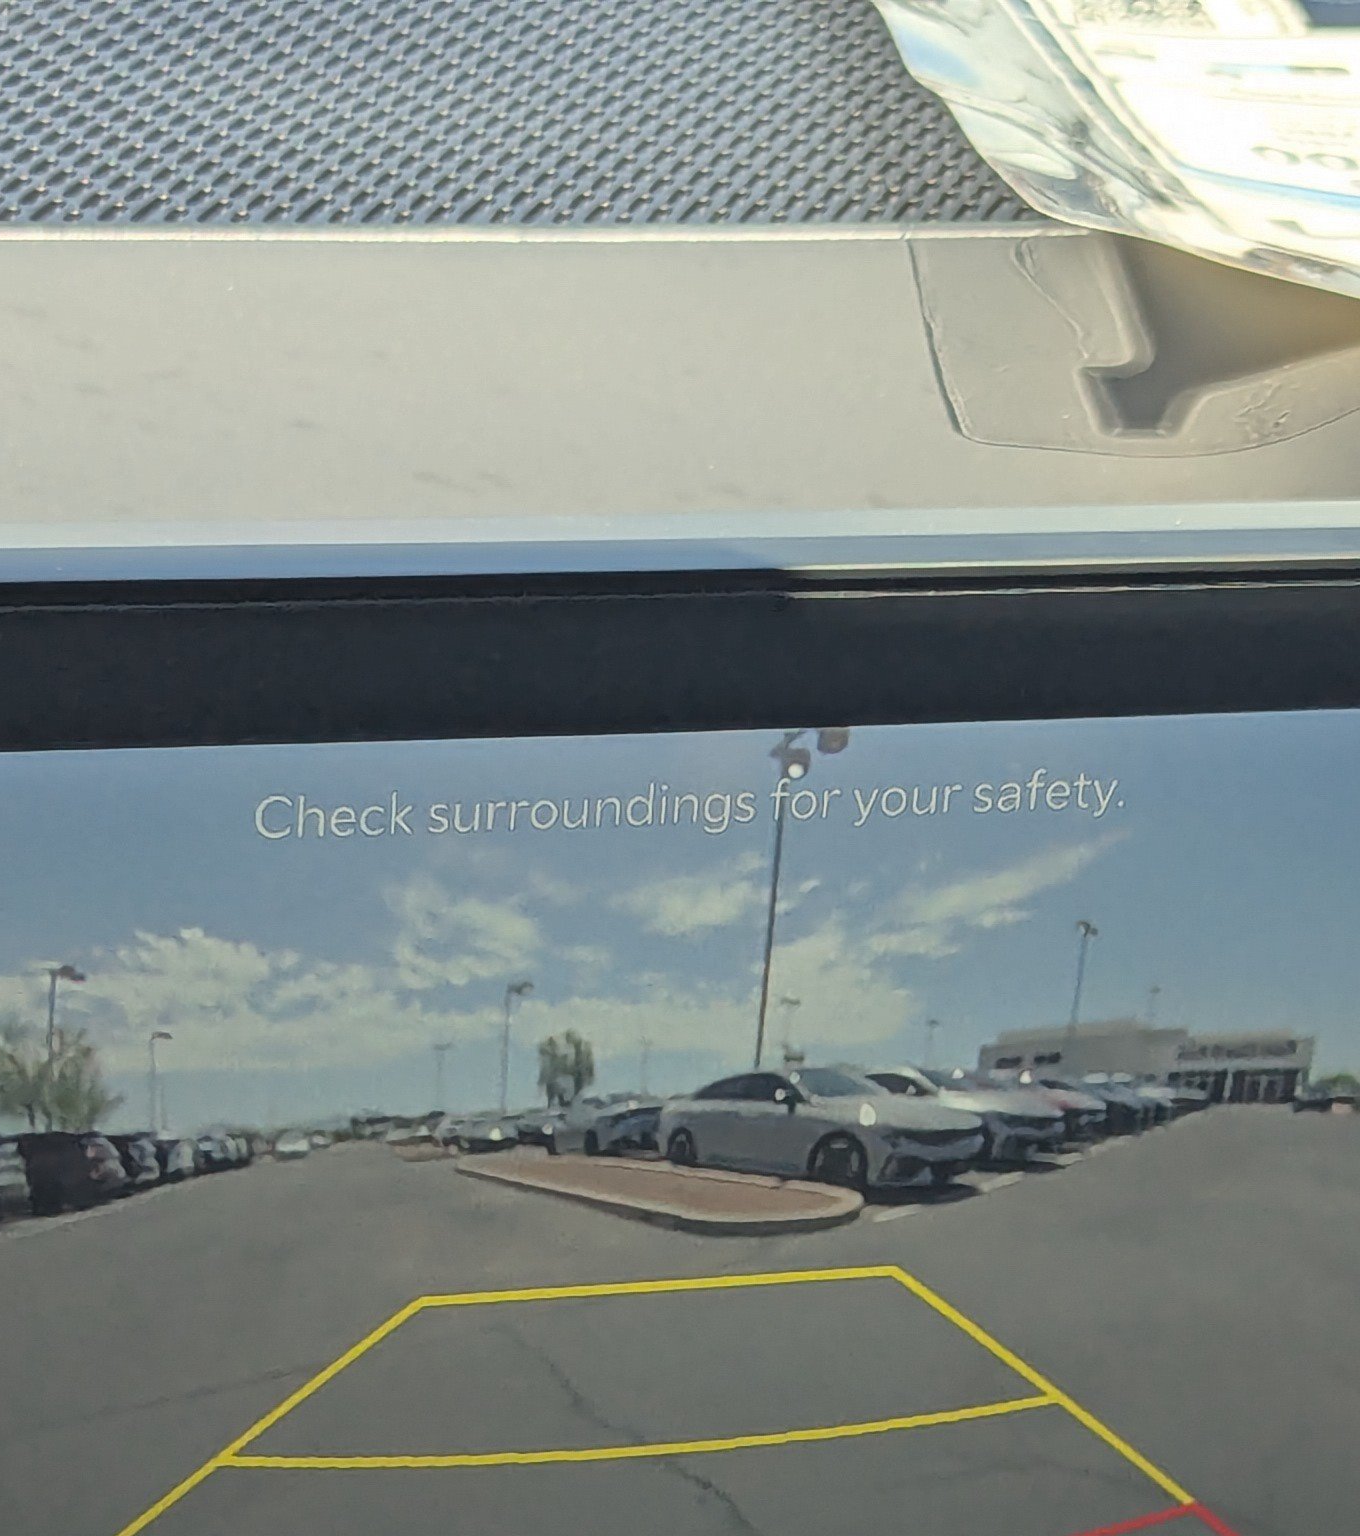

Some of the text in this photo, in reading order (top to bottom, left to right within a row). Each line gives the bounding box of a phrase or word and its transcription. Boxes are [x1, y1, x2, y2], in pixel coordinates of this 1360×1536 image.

[254, 769, 1126, 840] Check surroundings for your safety.
